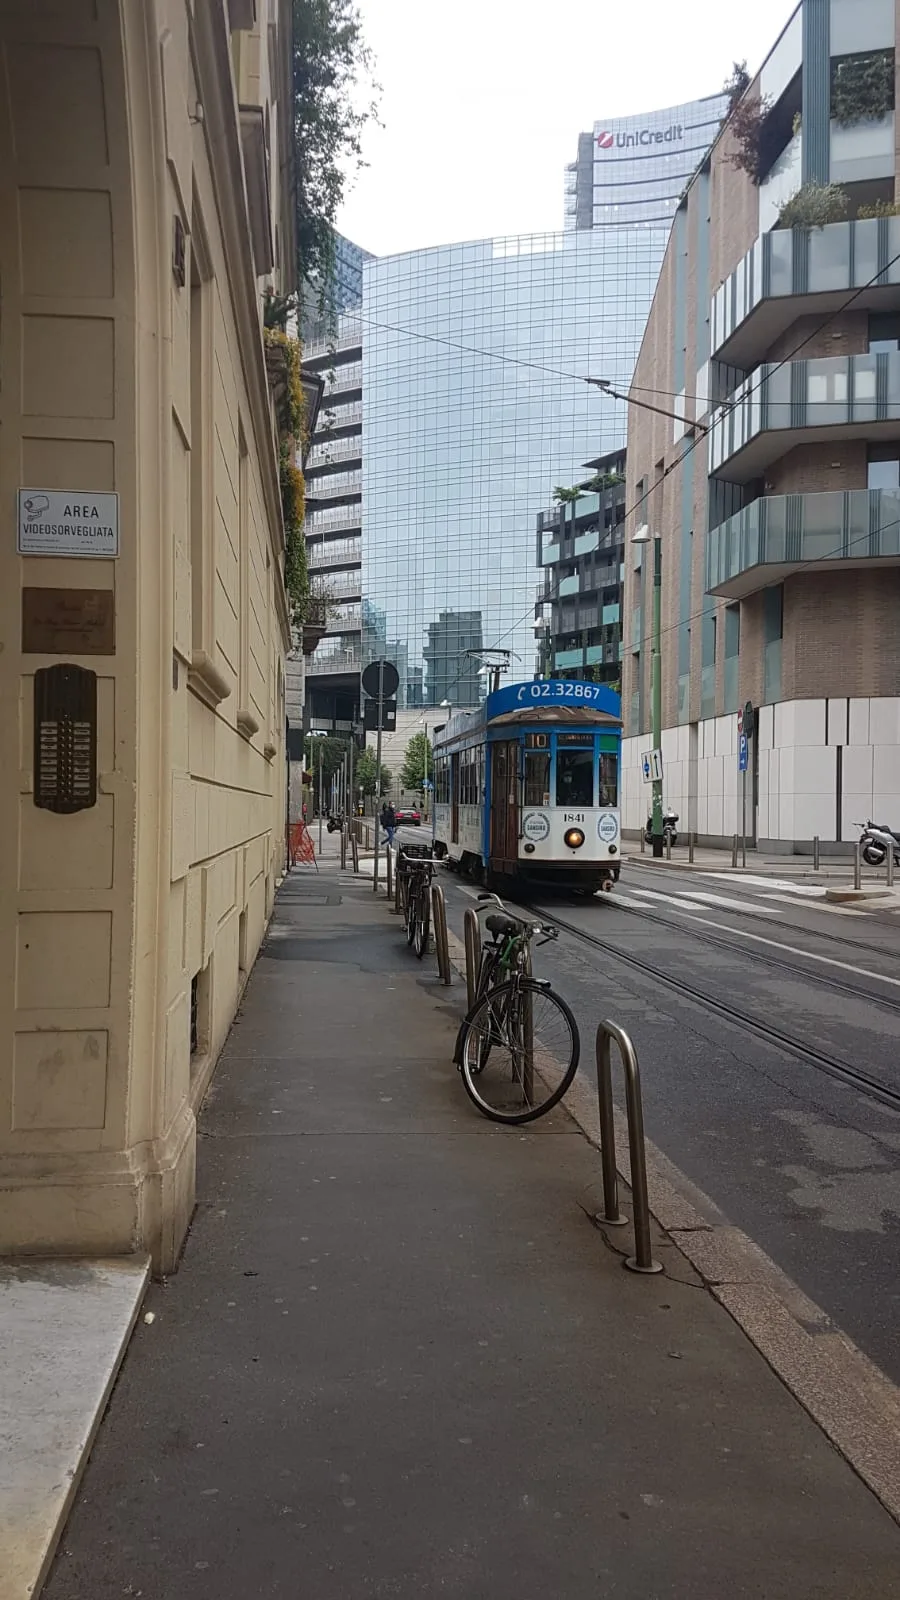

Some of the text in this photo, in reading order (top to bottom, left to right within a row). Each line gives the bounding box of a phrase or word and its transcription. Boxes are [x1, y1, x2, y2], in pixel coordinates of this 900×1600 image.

[616, 124, 683, 148] UniCredit
[63, 505, 99, 518] AREA
[23, 523, 114, 538] VIDEOSORVEGLIATA
[530, 683, 600, 700] 02.32867
[531, 733, 547, 749] 10
[564, 813, 585, 822] 1841
